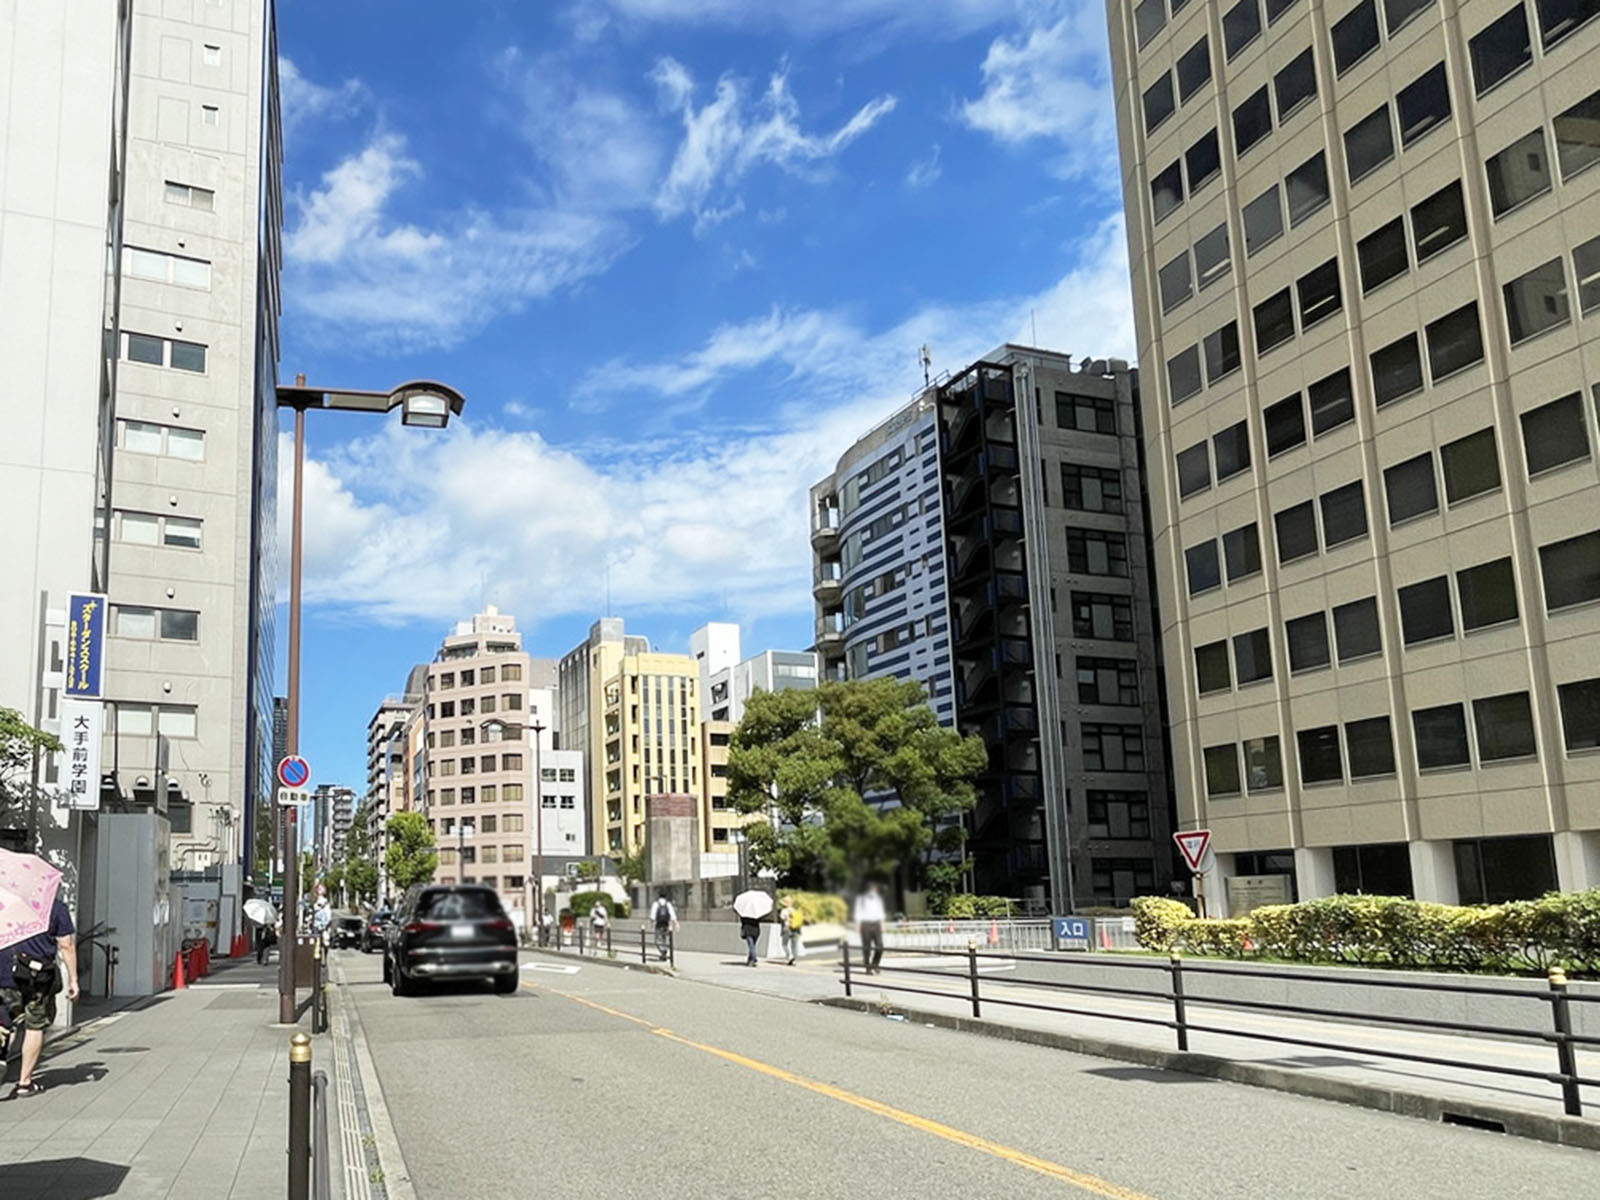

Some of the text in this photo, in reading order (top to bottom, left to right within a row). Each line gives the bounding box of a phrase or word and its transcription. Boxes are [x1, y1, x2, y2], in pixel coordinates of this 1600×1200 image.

[72, 716, 90, 794] 大手前学園
[1060, 921, 1083, 936] 入口
